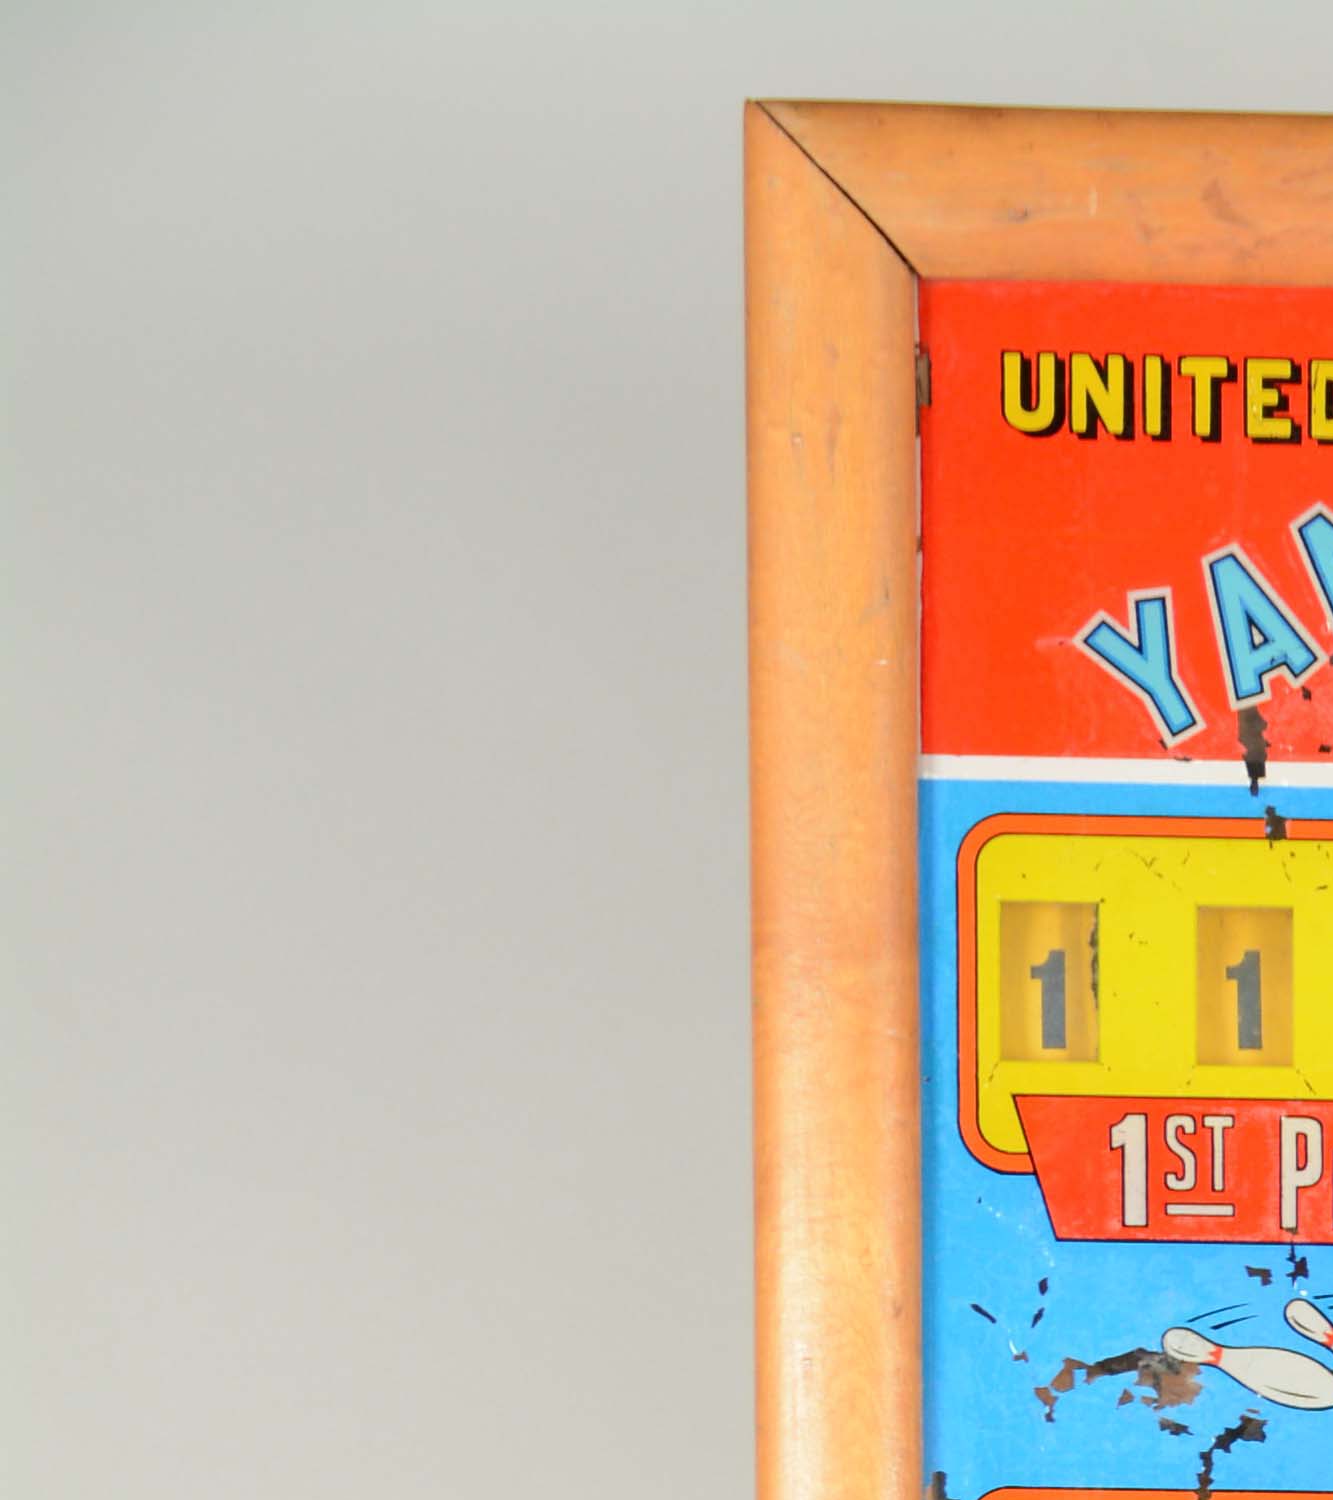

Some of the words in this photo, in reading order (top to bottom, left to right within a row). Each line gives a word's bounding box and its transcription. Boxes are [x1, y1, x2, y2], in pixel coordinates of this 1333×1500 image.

[1029, 948, 1067, 1050] 1
[1225, 949, 1263, 1050] 1
[1109, 1112, 1235, 1228] 1ST
